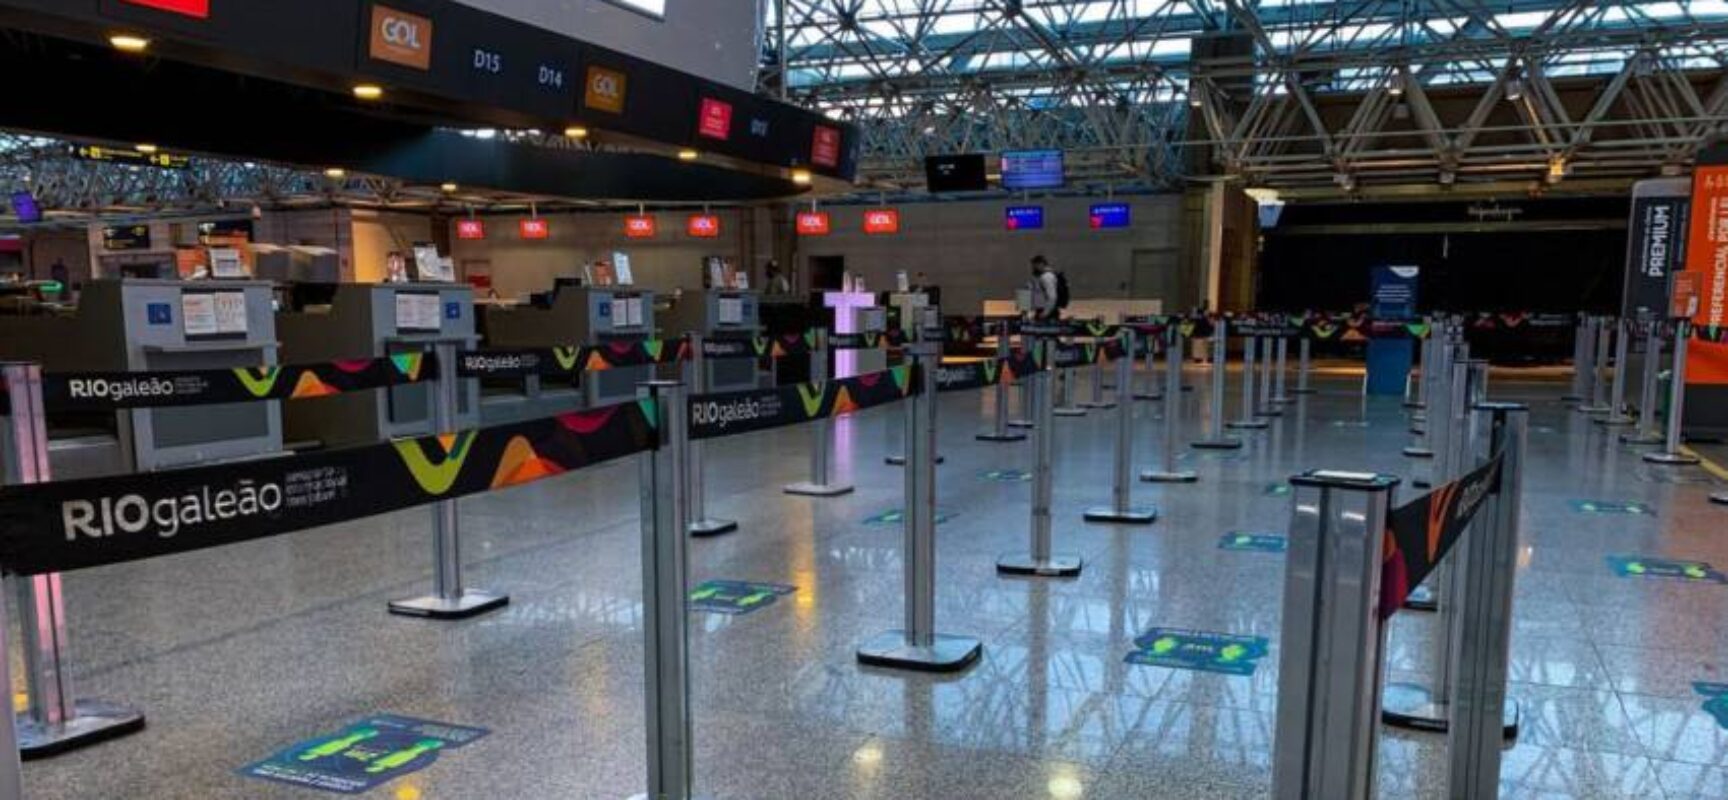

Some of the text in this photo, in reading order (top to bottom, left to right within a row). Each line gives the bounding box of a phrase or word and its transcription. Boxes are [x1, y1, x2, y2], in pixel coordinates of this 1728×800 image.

[381, 17, 422, 49] GOL
[474, 50, 500, 73] D15
[539, 66, 563, 89] D14
[592, 75, 619, 98] GOL
[1648, 205, 1670, 277] PREMIUM
[69, 377, 174, 401] RIOgaleão
[692, 396, 760, 427] RIOgaleão
[62, 479, 282, 541] RIOgaleão
